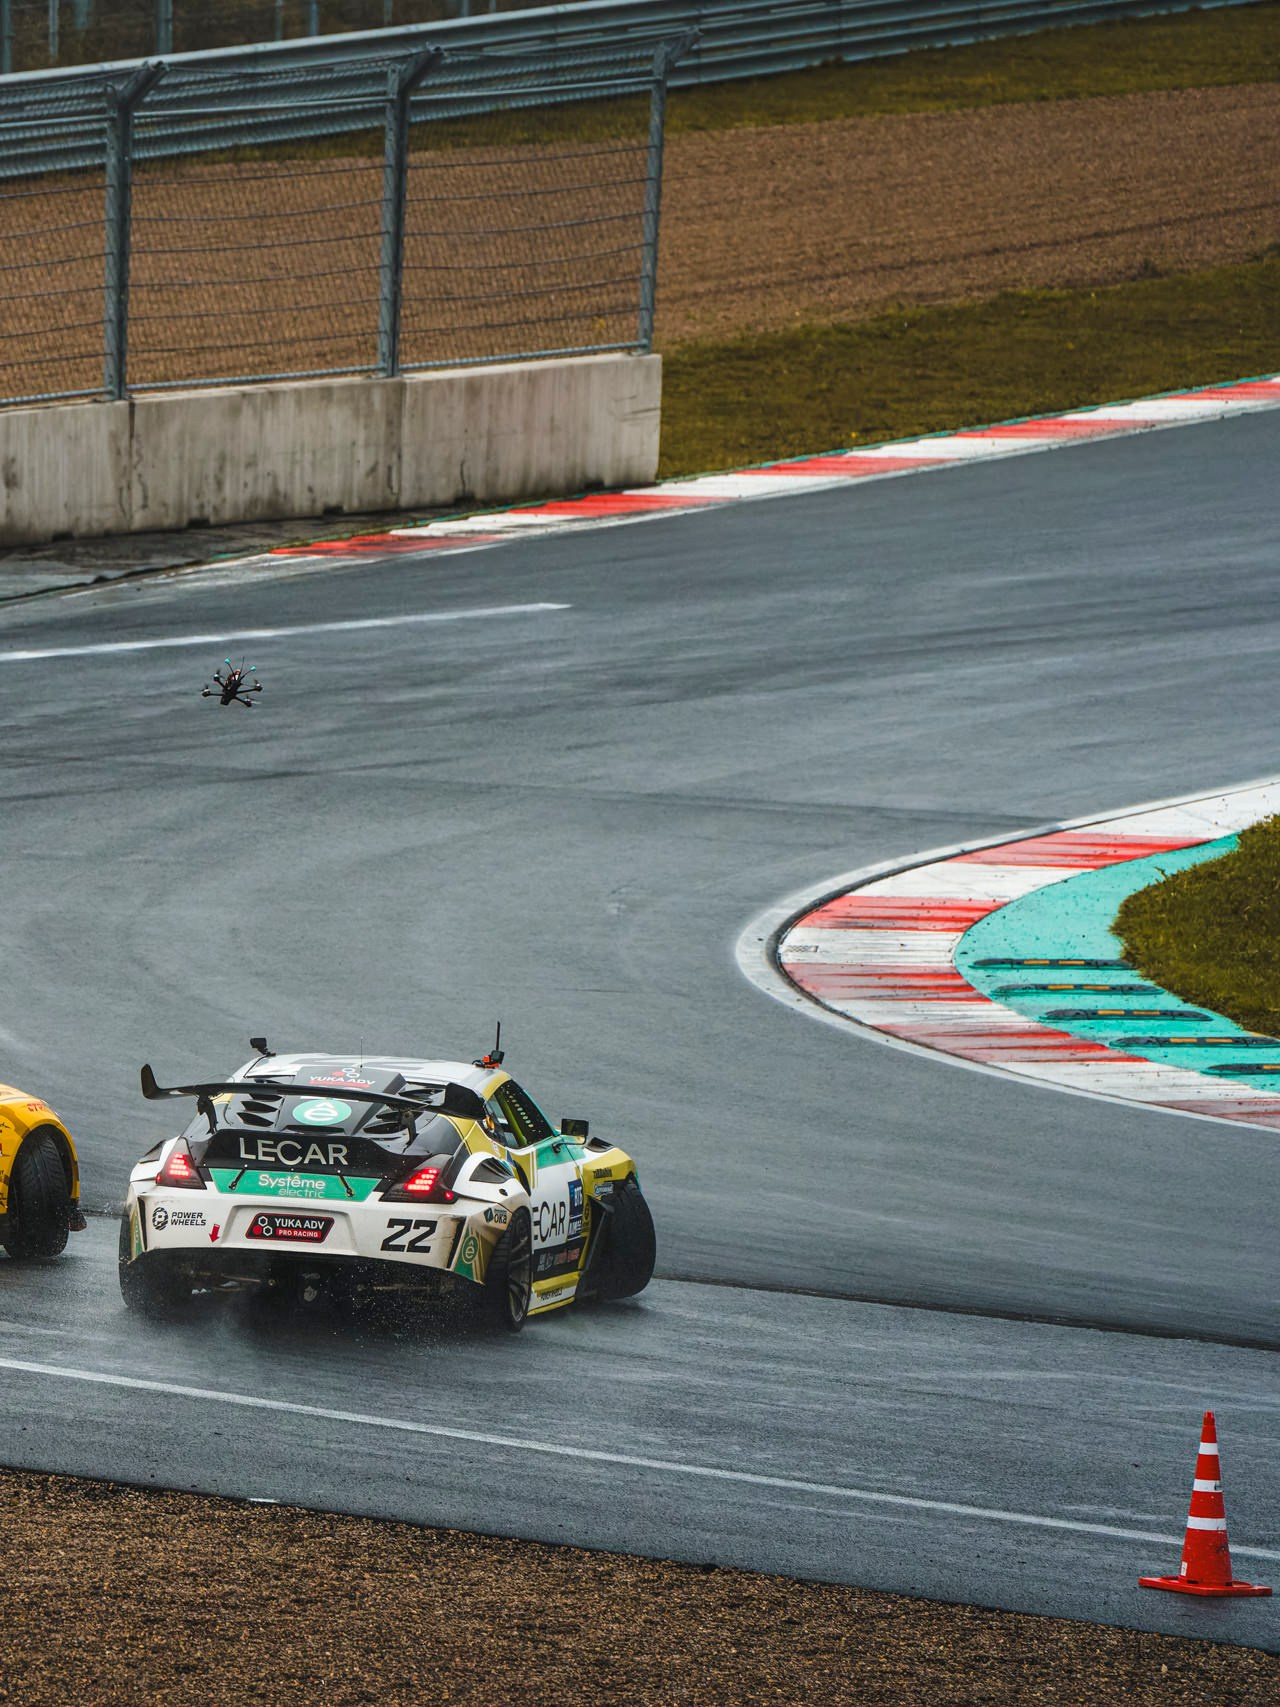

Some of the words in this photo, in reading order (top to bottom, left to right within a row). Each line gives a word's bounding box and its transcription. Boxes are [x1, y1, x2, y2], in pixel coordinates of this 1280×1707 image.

[239, 1137, 349, 1166] LECAR
[258, 1174, 326, 1189] Système
[278, 1187, 325, 1198] electric
[275, 1218, 301, 1228] YUKA
[303, 1220, 325, 1230] ADV
[293, 1230, 319, 1238] RACING
[380, 1218, 438, 1254] 22
